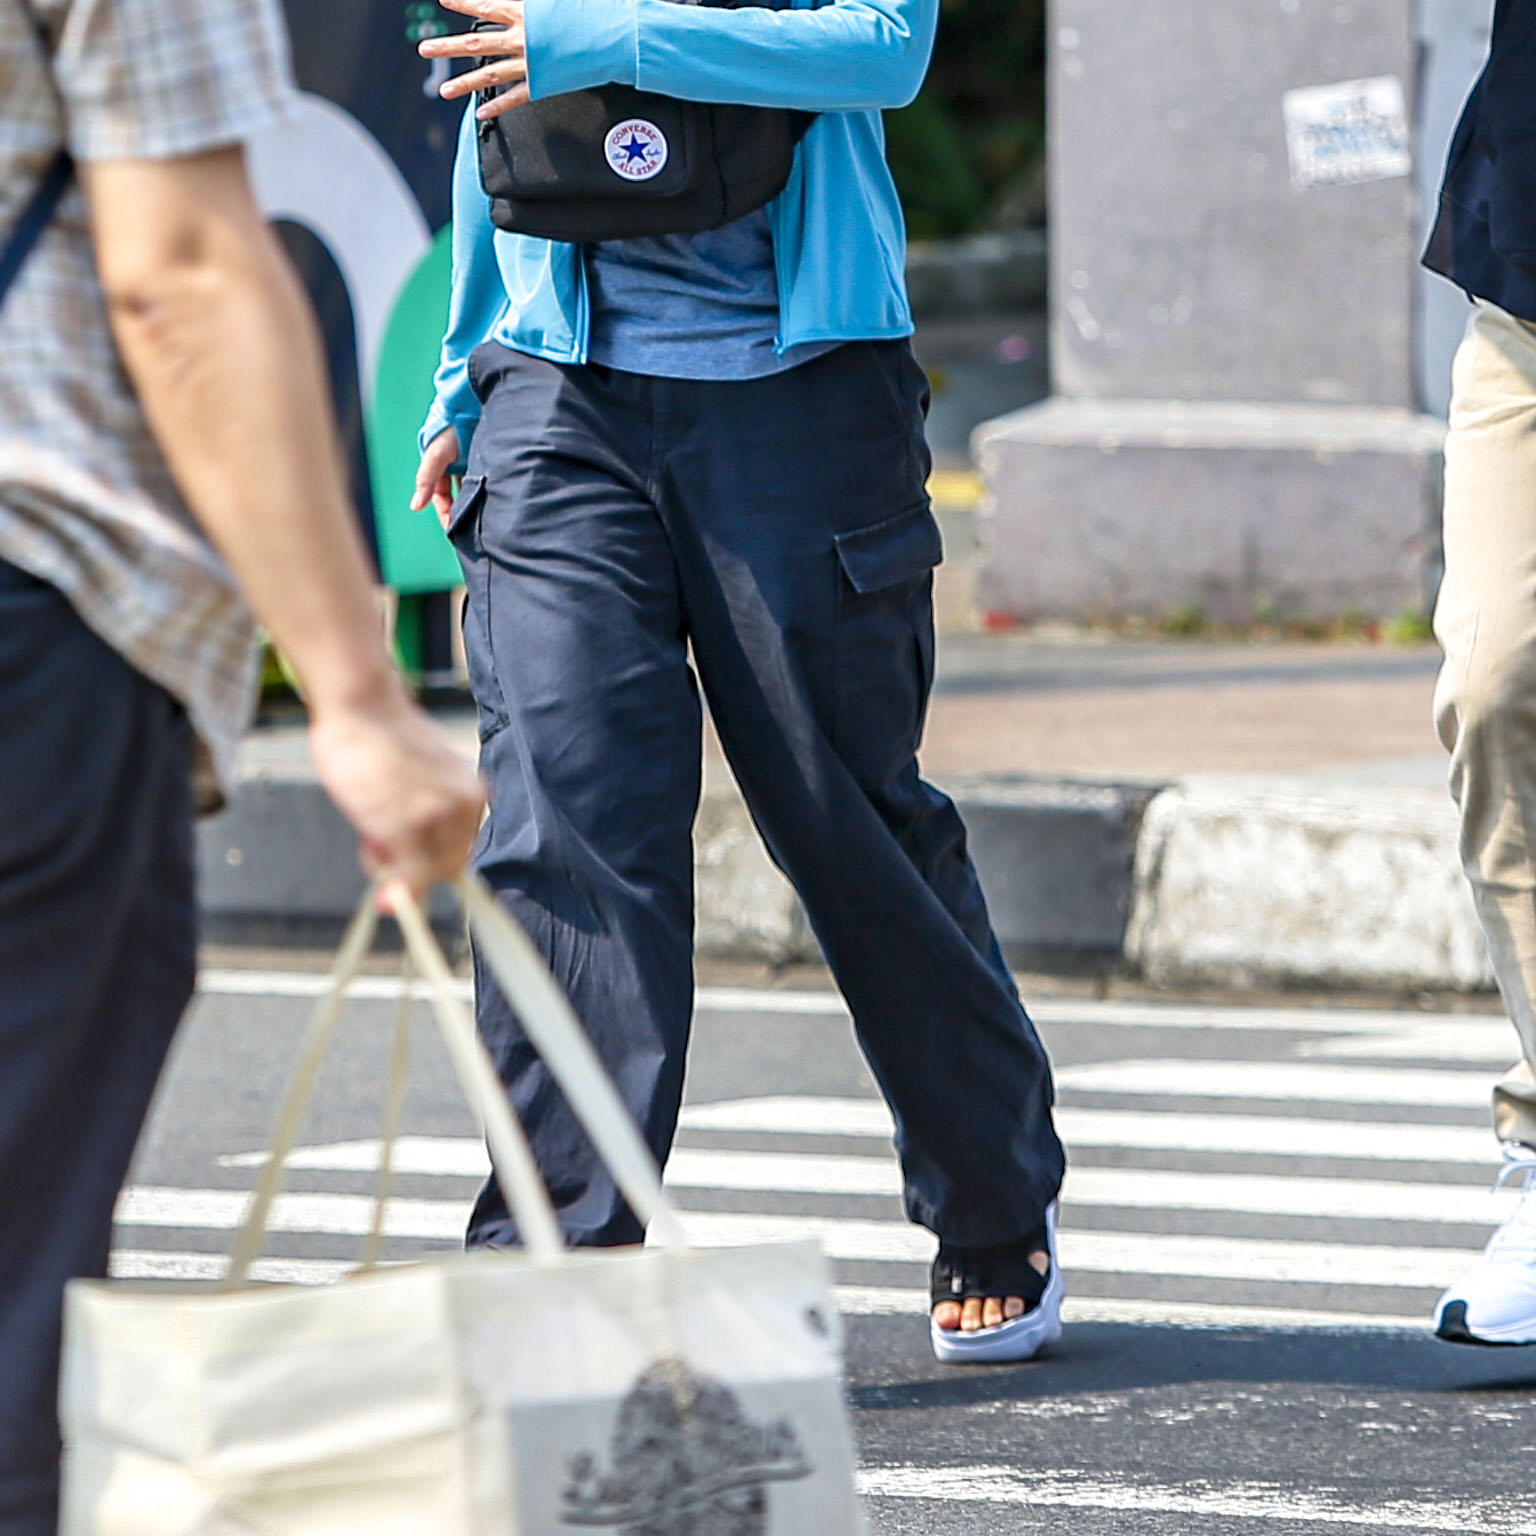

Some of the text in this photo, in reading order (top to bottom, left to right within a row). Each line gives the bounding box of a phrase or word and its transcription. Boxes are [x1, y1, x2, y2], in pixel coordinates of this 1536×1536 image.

[612, 124, 657, 145] CONVERSE
[618, 159, 657, 175] ALL STAR
